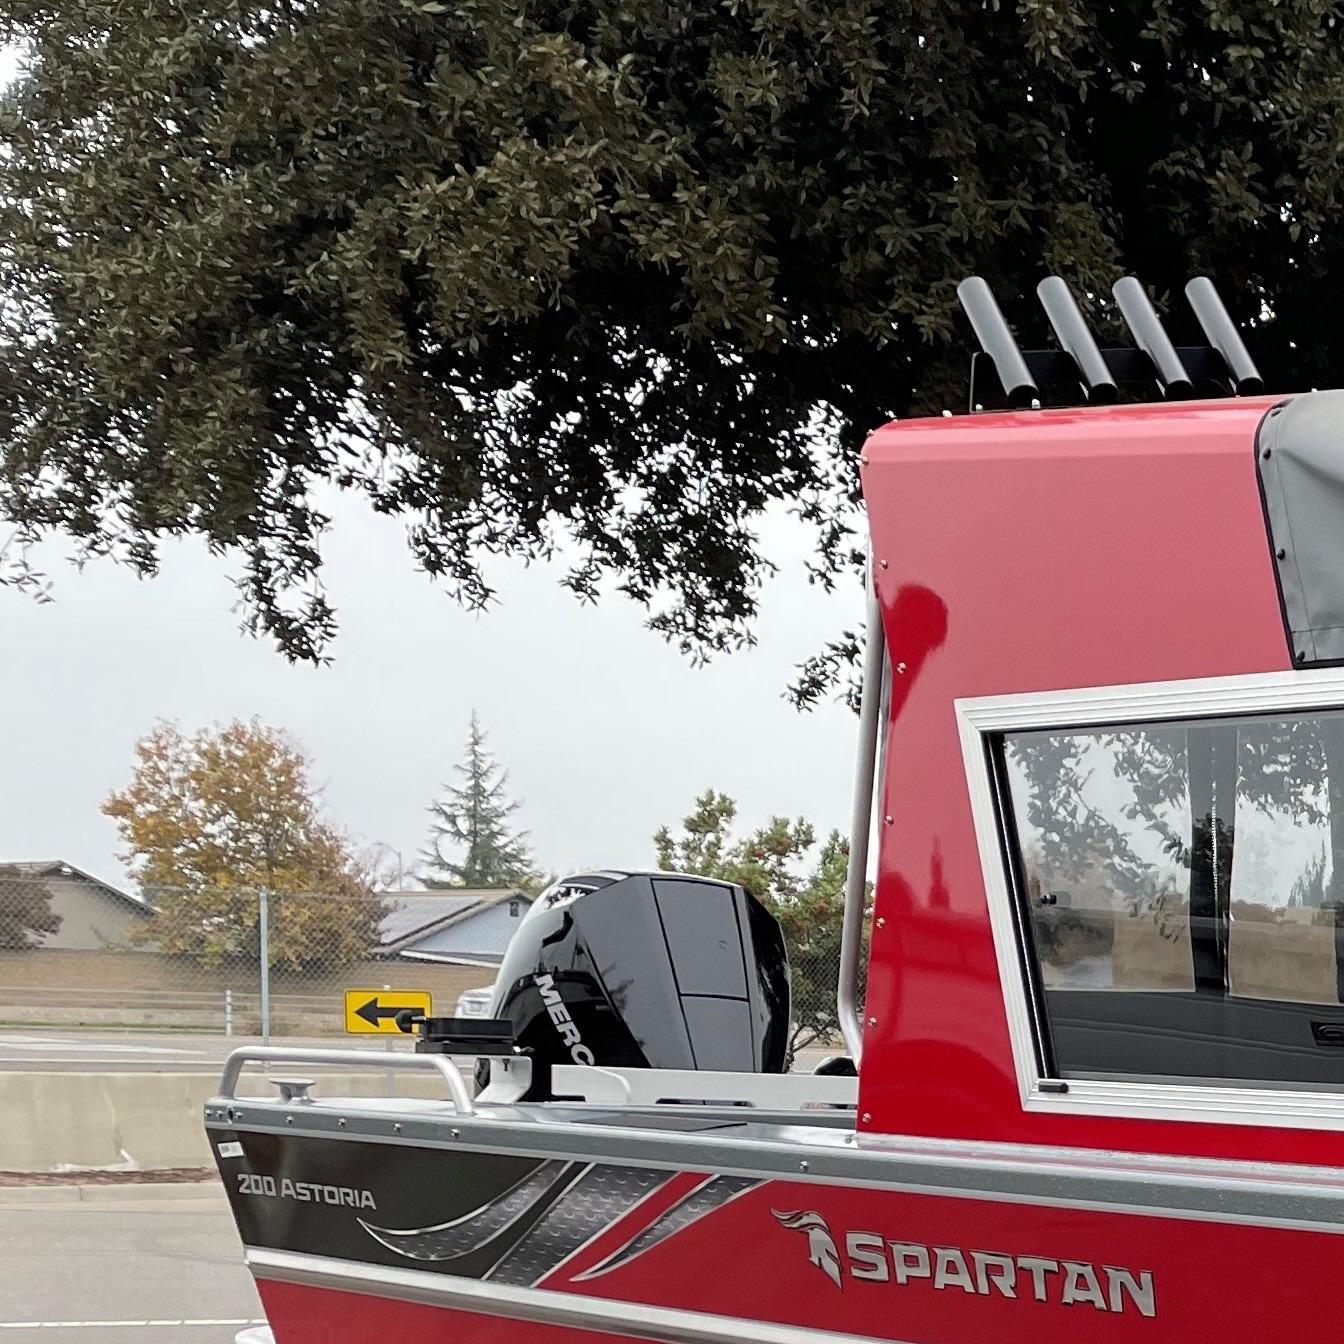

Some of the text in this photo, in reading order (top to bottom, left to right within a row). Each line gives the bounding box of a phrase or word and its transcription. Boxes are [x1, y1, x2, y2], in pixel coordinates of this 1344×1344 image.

[237, 1173, 377, 1210] 200 ASTORIA
[845, 1230, 1157, 1318] SPARTAN
